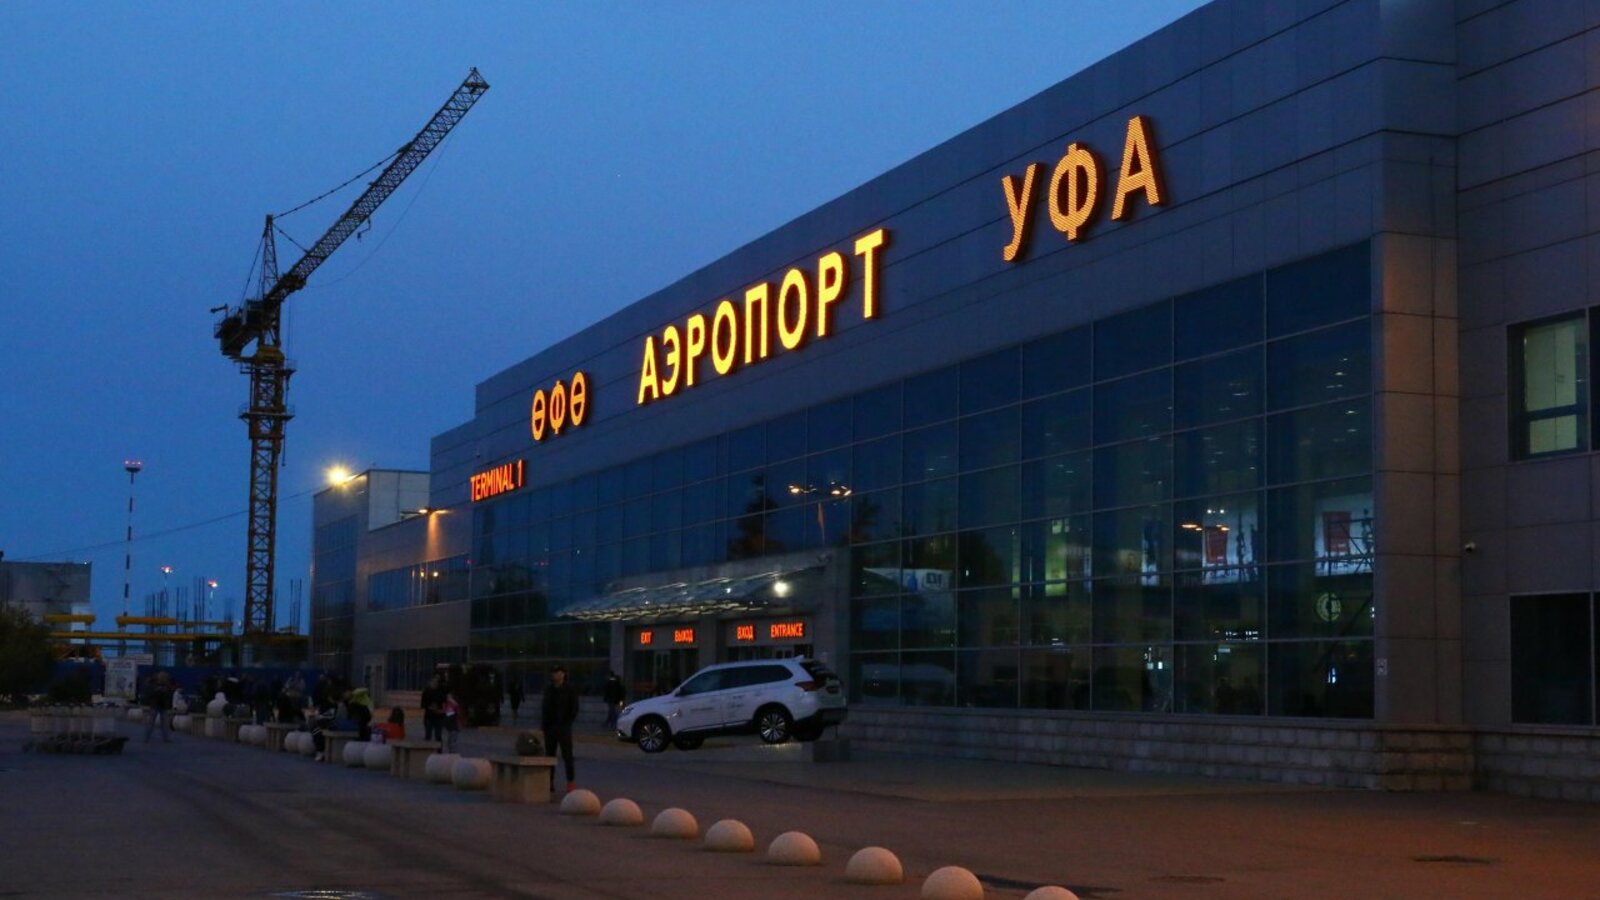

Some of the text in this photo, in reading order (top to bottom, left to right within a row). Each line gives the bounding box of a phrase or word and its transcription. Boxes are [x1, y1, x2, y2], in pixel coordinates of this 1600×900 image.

[637, 115, 1162, 404] АЭРОПОРТ УФА
[470, 459, 525, 502] TERMINAL 1
[640, 631, 652, 645] EXIT
[674, 628, 695, 643] ВЫХОД
[736, 625, 755, 640] ВХОД
[770, 623, 804, 638] ENTRANCE
